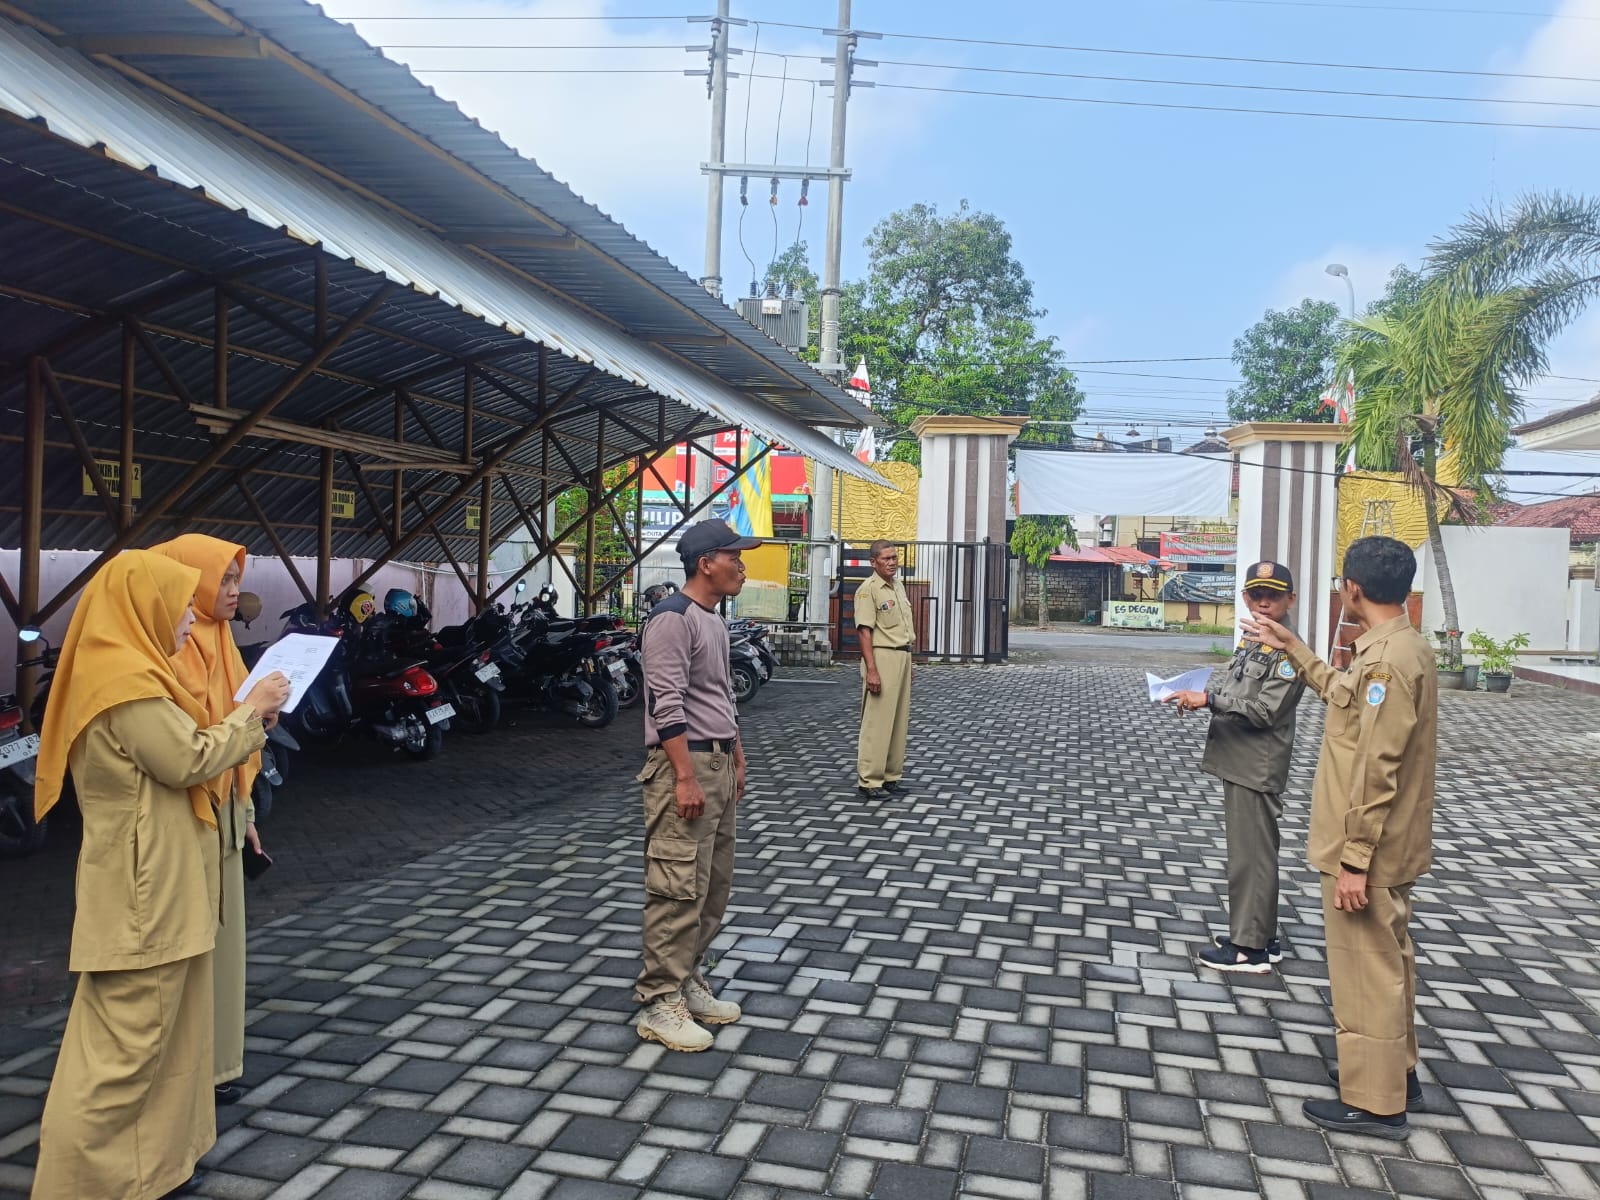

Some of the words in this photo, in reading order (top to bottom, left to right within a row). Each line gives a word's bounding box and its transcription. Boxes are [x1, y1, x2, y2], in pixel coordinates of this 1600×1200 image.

[134, 467, 139, 480] 2
[1114, 605, 1126, 614] ES
[1128, 605, 1159, 615] DEGAN
